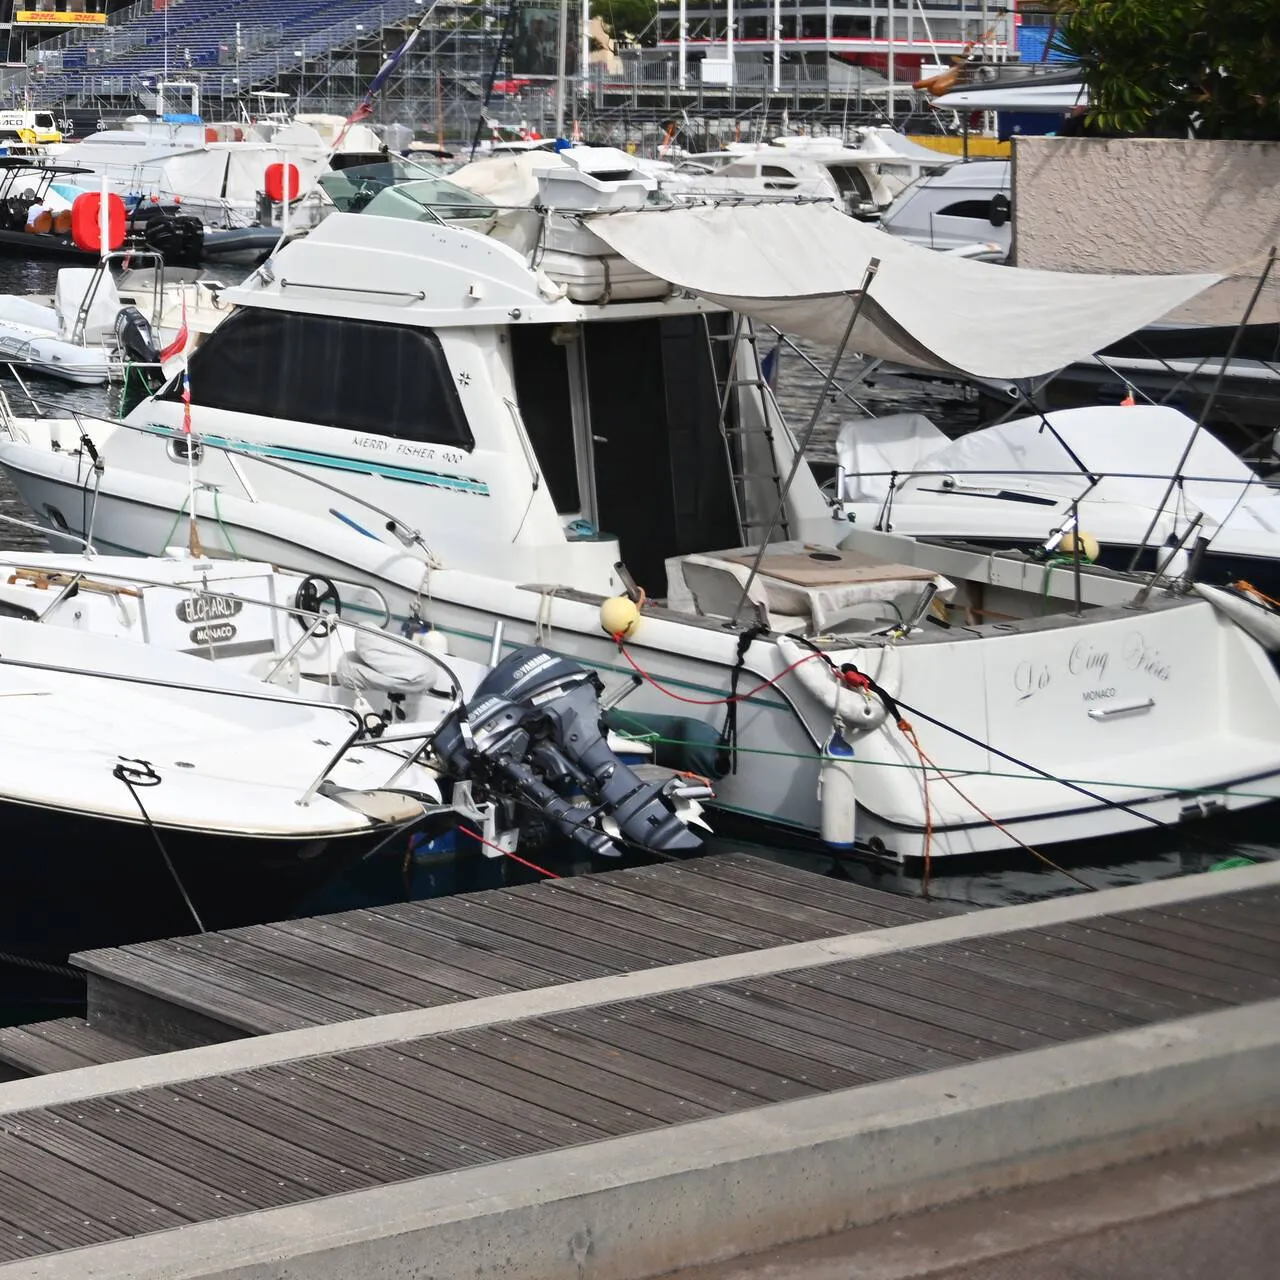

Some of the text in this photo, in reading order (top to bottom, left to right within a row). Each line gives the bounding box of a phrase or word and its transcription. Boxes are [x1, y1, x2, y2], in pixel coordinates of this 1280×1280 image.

[197, 626, 233, 641] MONACO
[520, 653, 552, 674] YAMAHA
[1081, 687, 1117, 702] MONACO
